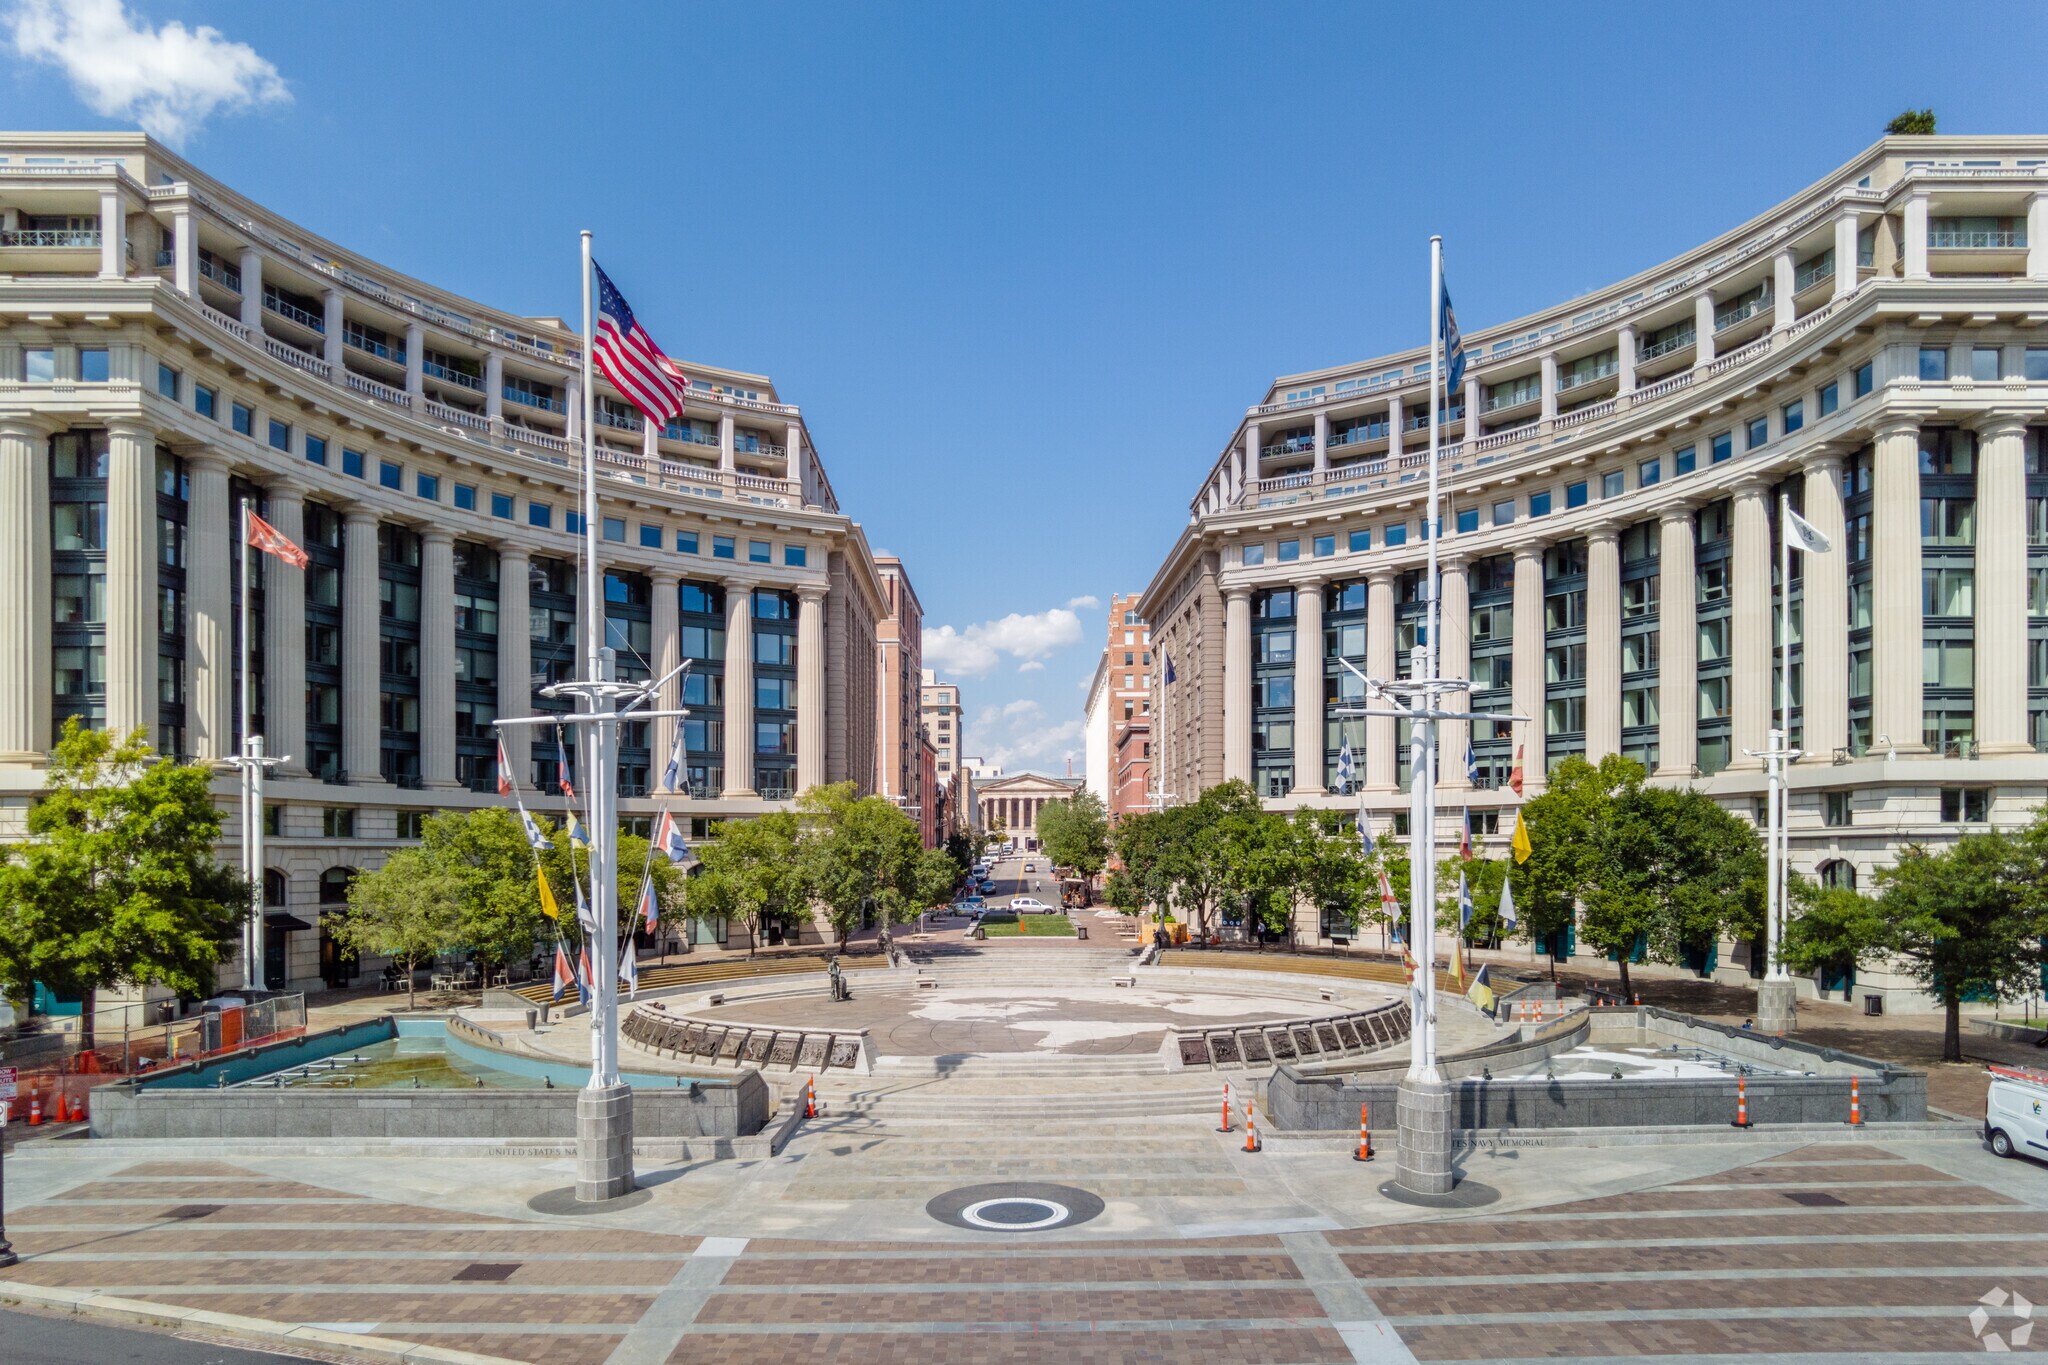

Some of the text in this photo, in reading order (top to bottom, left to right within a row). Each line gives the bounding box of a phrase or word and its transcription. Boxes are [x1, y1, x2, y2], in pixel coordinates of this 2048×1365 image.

[1452, 1139, 1545, 1148] TES NAVY MEMORIAL
[488, 1147, 578, 1156] UNITED STATES NA
